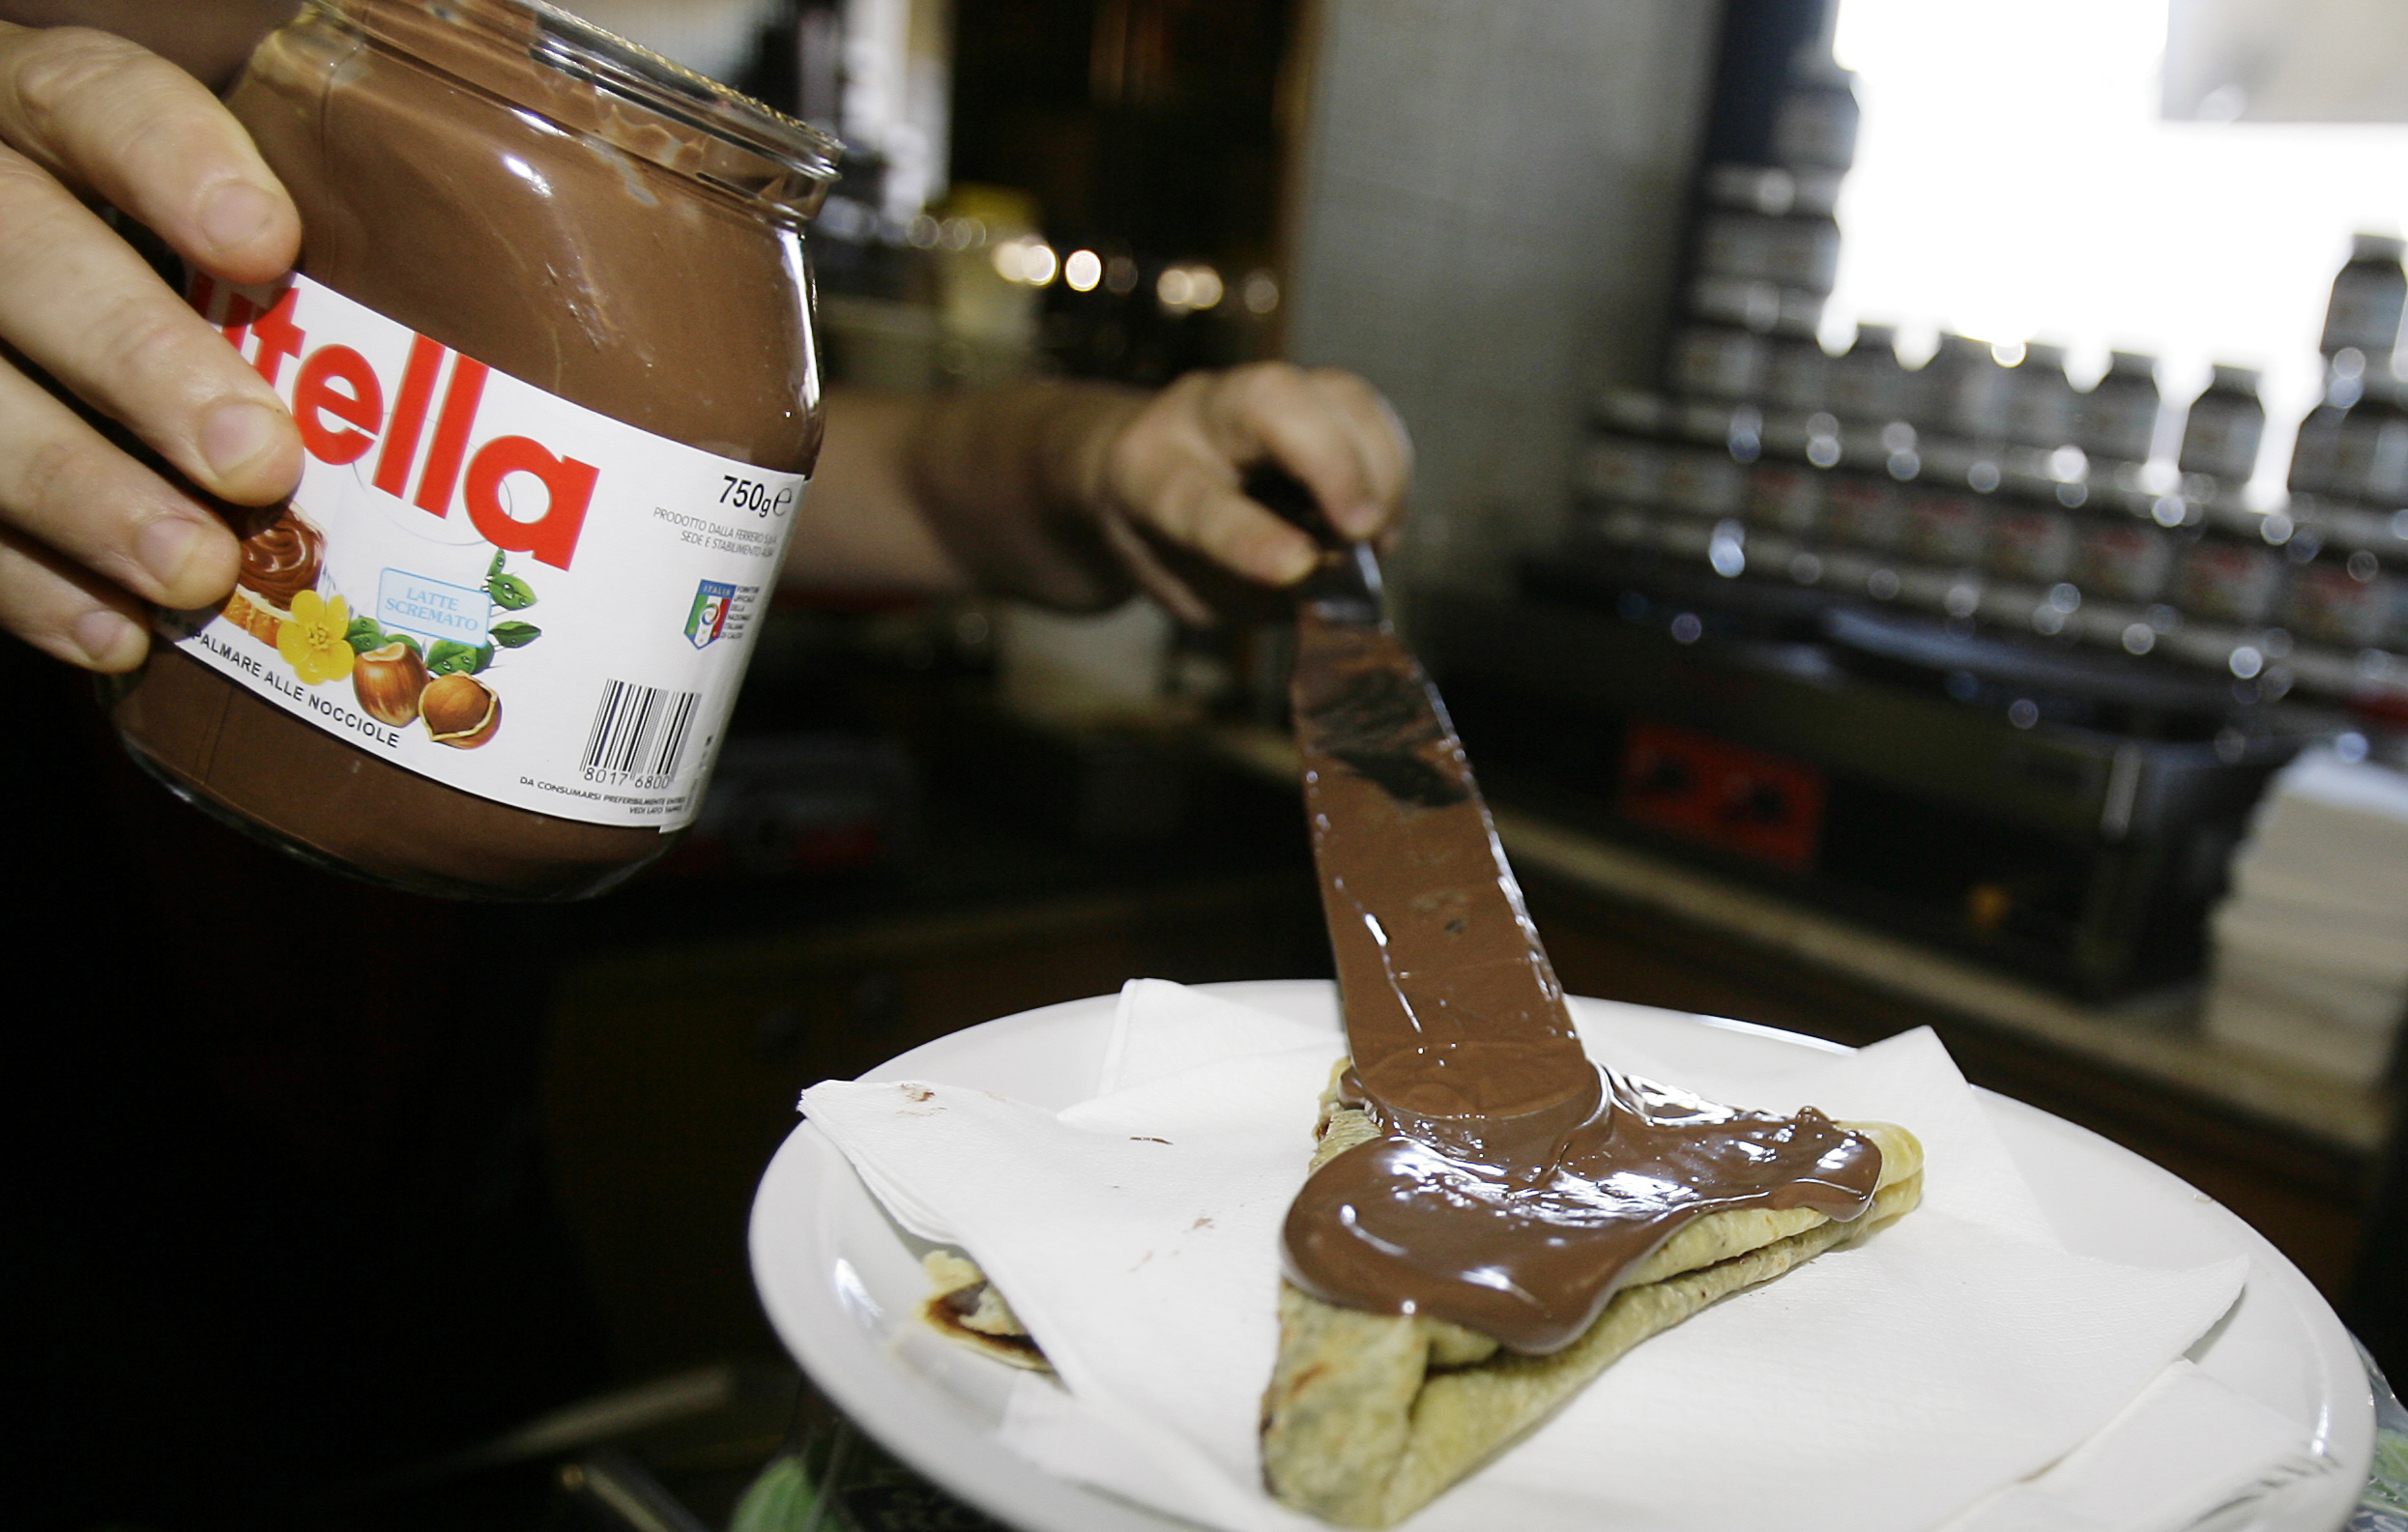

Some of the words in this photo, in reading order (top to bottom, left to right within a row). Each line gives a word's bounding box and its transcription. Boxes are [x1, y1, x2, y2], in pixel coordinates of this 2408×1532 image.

[653, 506, 707, 531] PRODOTTO
[708, 522, 734, 538] DALLA
[681, 530, 704, 546] SEDE
[705, 536, 711, 547] E
[712, 537, 762, 557] STABILIMENTO
[406, 587, 459, 612] LATTE
[703, 585, 731, 595] ITALIA
[385, 597, 479, 631] SCREMATO
[264, 670, 305, 702] ALLE
[308, 693, 401, 749] NOCCIOLE
[519, 776, 535, 787] DA
[537, 781, 600, 800] CONSUMARSI
[629, 806, 648, 815] VEDI
